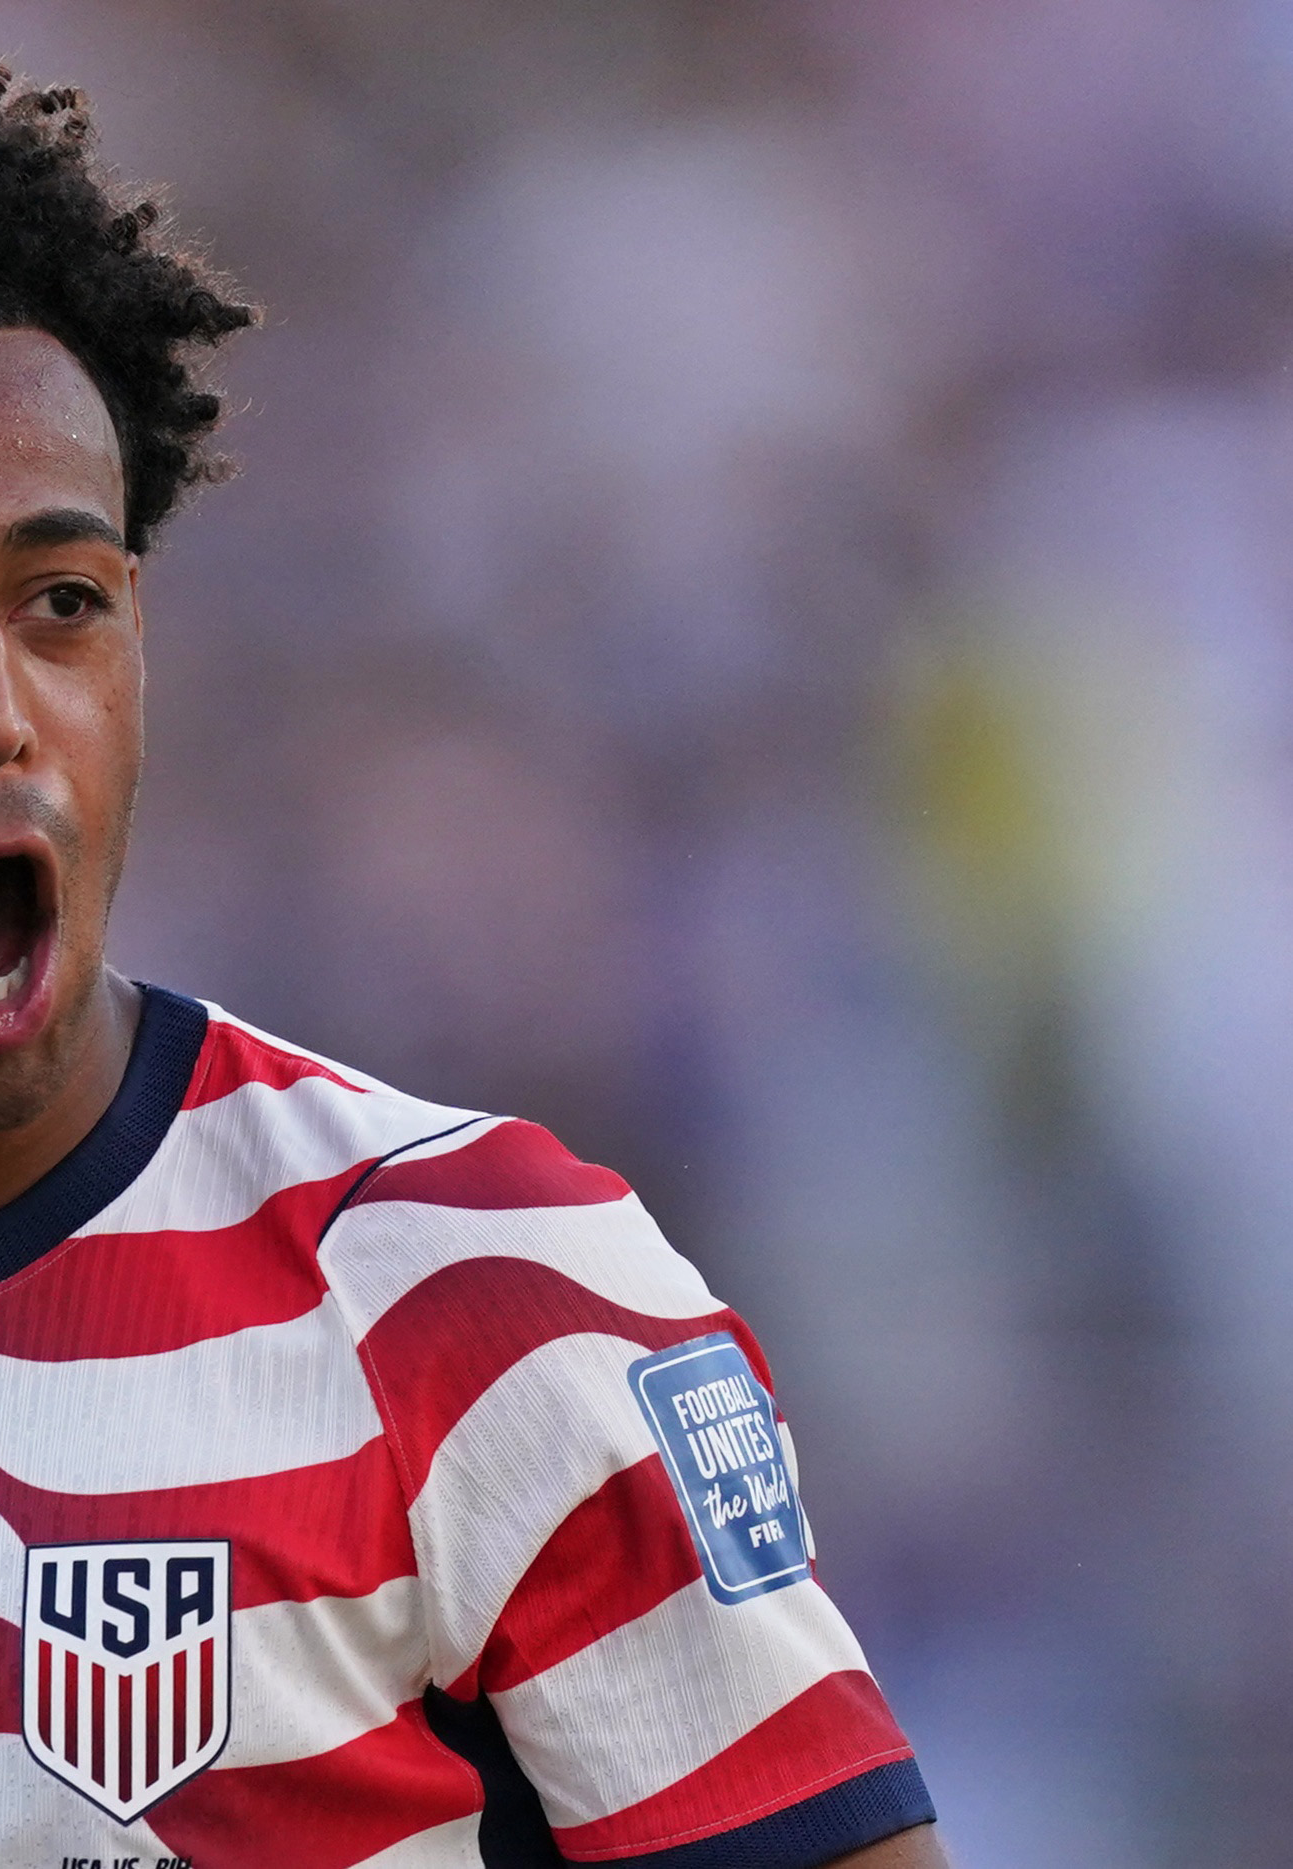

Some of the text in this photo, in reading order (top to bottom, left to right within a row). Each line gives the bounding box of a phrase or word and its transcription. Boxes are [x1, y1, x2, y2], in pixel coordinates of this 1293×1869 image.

[672, 1374, 758, 1429] FOOTBALL
[687, 1411, 774, 1480] UNITES
[703, 1464, 790, 1529] the World
[40, 1557, 214, 1659] USA
